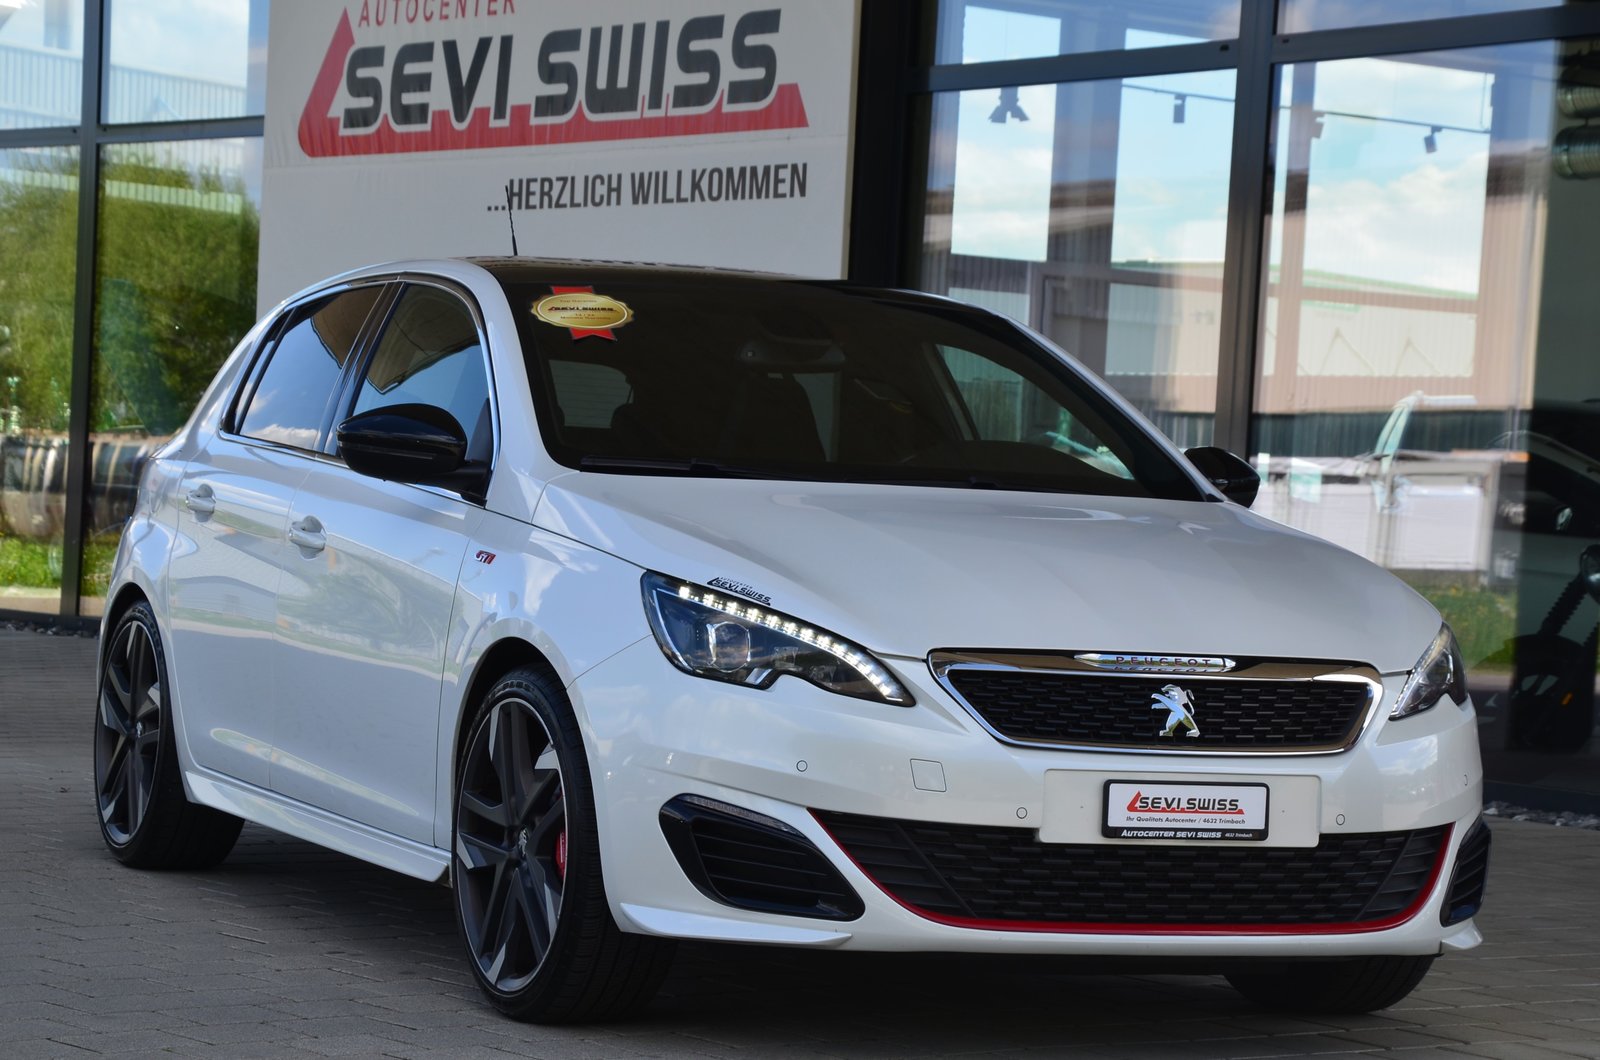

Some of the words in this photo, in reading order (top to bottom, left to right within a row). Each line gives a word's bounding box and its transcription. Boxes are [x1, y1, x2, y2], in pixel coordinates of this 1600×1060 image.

[343, 35, 513, 129] SEVI
[531, 8, 782, 118] SWISS
[630, 163, 807, 206] WILLKOMMEN
[715, 580, 739, 591] SEVI
[739, 586, 771, 602] SWISS
[1115, 656, 1211, 666] PEUGEOT
[1139, 797, 1181, 809] SEVI
[1186, 798, 1239, 810] SWISS
